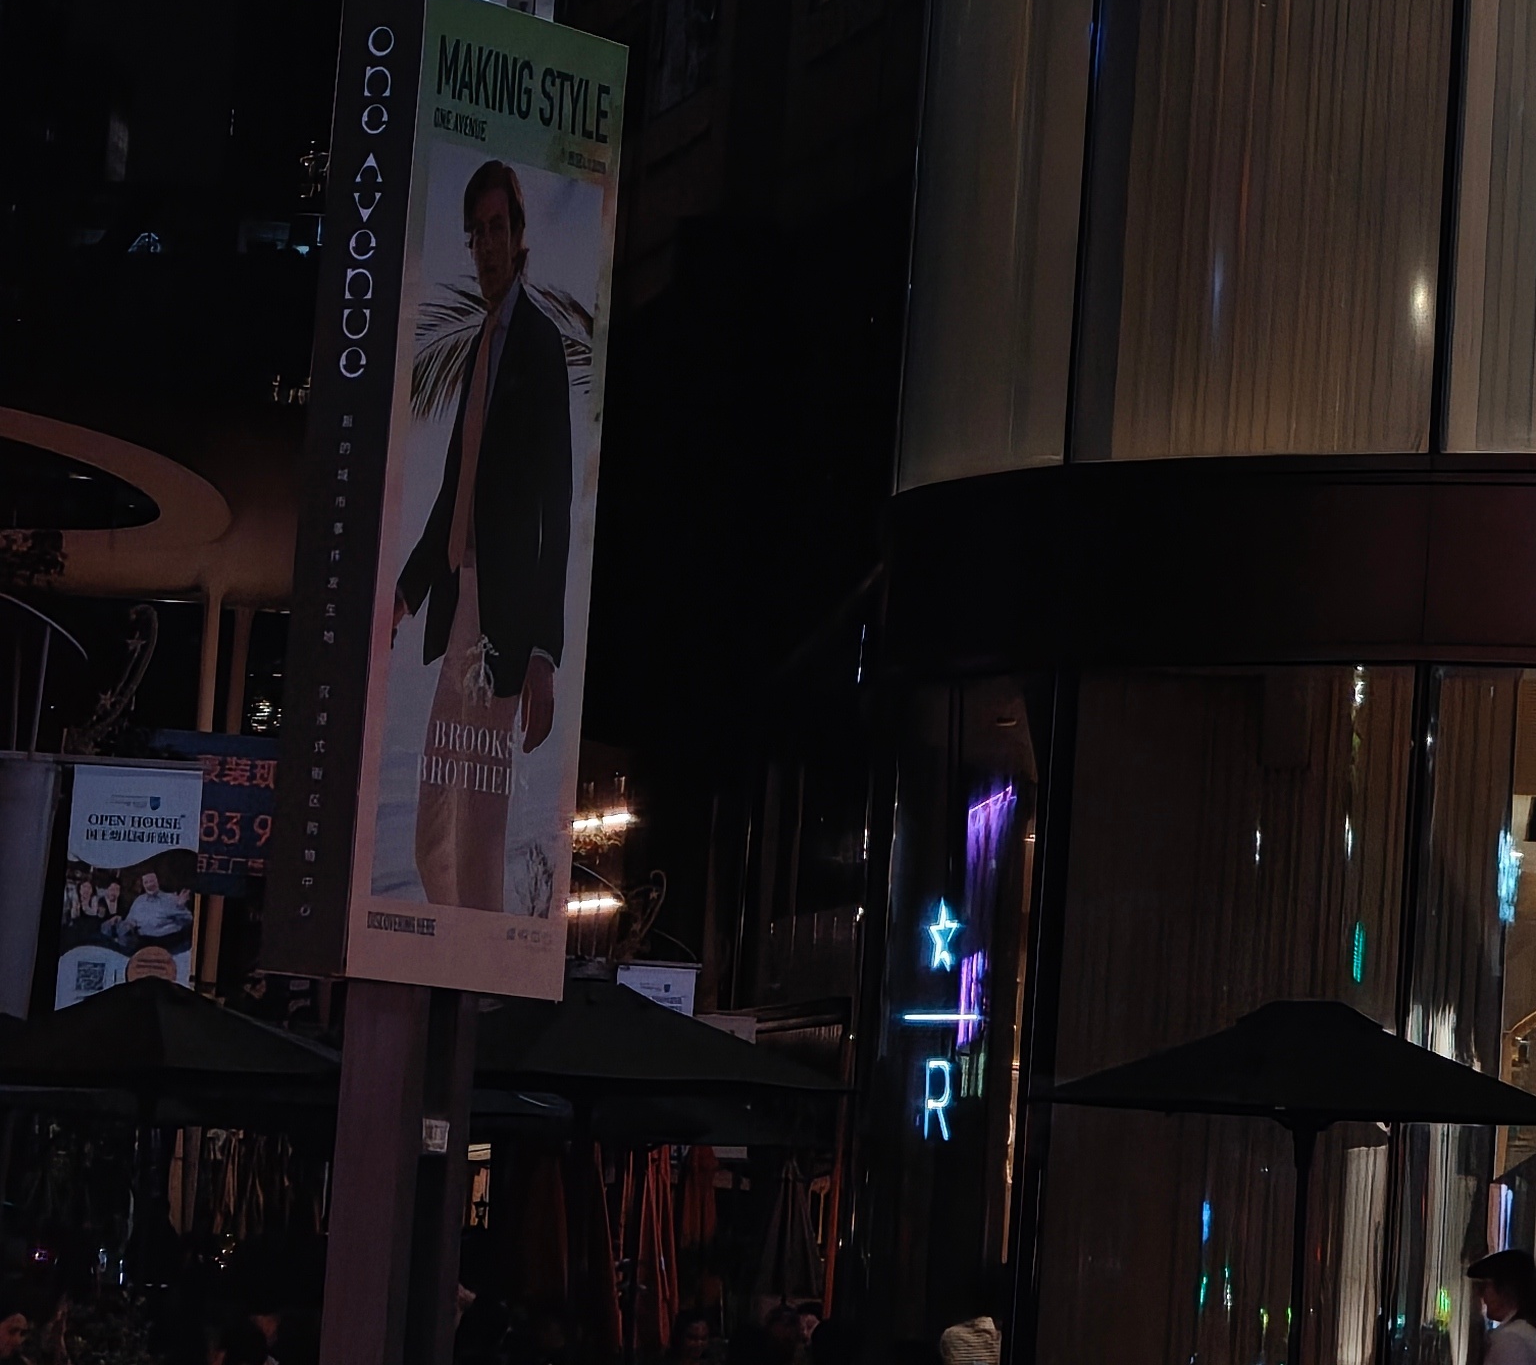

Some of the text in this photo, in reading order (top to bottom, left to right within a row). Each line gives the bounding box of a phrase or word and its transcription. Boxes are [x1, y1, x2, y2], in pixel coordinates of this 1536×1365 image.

[436, 35, 611, 144] MAKING STYLE
[88, 813, 182, 829] OPEN HOUSE
[923, 1057, 951, 1141] R
